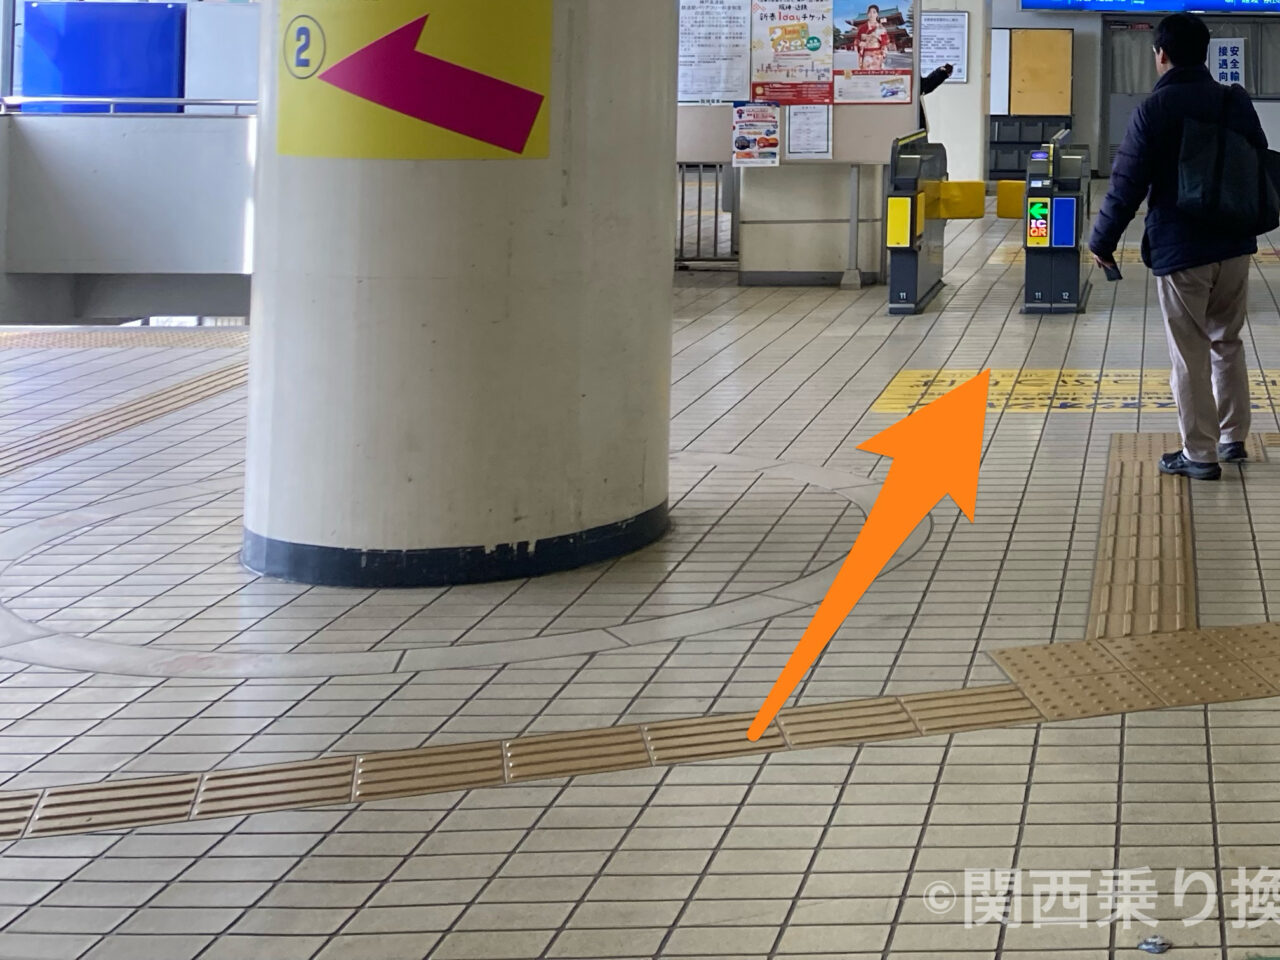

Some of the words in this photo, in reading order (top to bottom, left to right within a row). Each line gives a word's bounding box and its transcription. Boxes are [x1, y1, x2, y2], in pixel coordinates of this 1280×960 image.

[295, 26, 311, 68] 2
[1031, 219, 1047, 228] IC
[1030, 228, 1047, 237] QR
